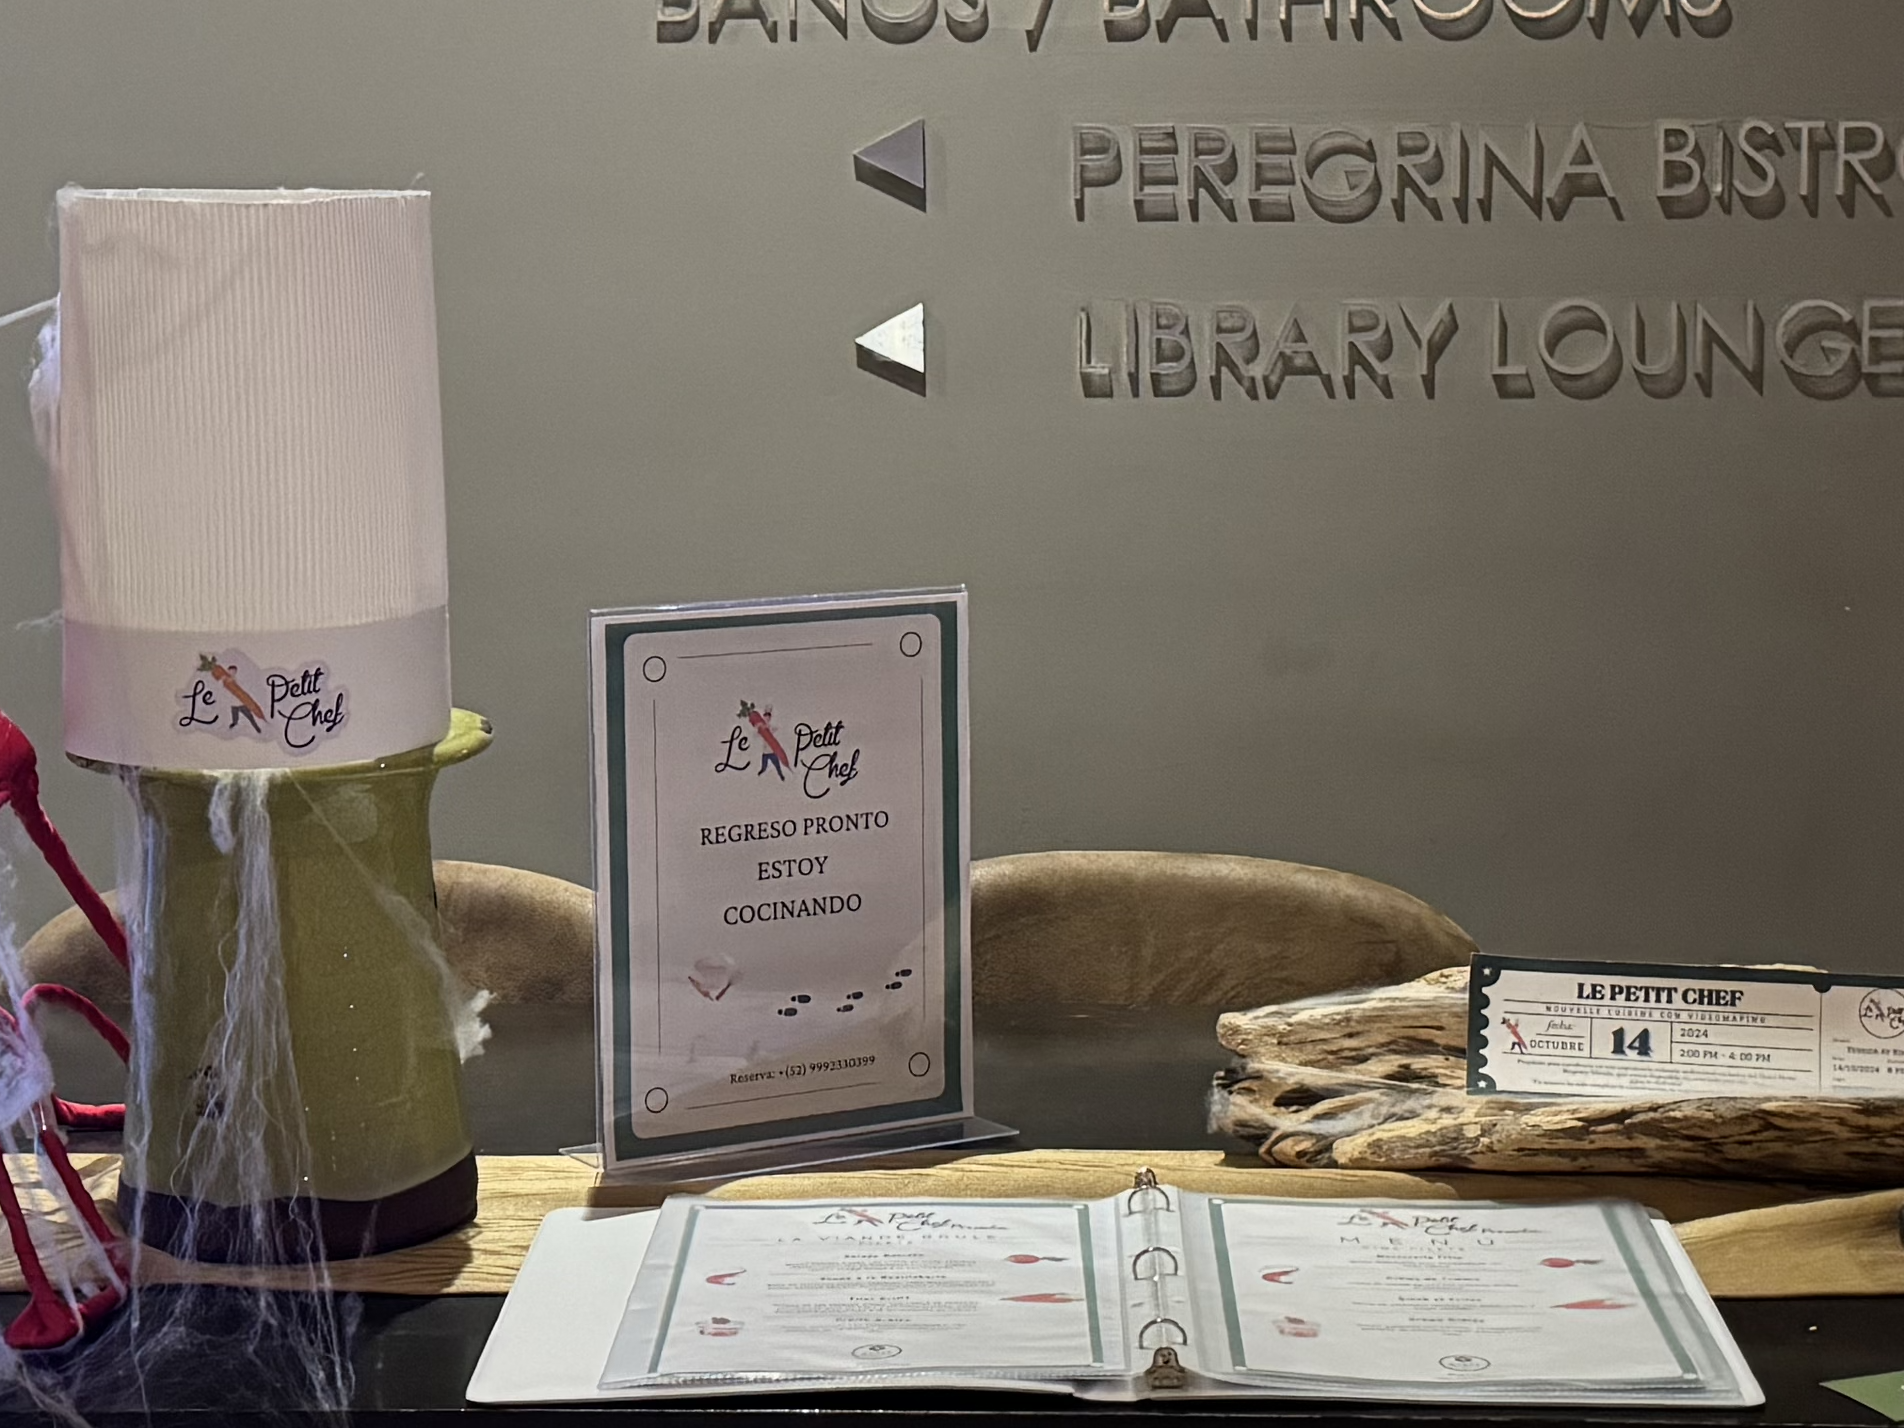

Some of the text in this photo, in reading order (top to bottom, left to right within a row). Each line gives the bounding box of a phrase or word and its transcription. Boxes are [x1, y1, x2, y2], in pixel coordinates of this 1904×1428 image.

[1071, 122, 1624, 225] PEREGRINA
[1078, 300, 1459, 402] LIBRARY
[179, 667, 325, 727] Le Petit
[278, 693, 346, 748] Chef
[715, 721, 844, 772] Le Petit
[801, 749, 860, 799] Chef
[700, 810, 889, 846] REGRESO PRONTO
[758, 855, 829, 881] ESTOY
[723, 893, 862, 925] COCINANDO
[1576, 982, 1744, 1007] LE PETIT CHEF
[1529, 1039, 1584, 1051] OCTUBRE
[1611, 1026, 1653, 1056] 14
[1679, 1028, 1709, 1039] 2024
